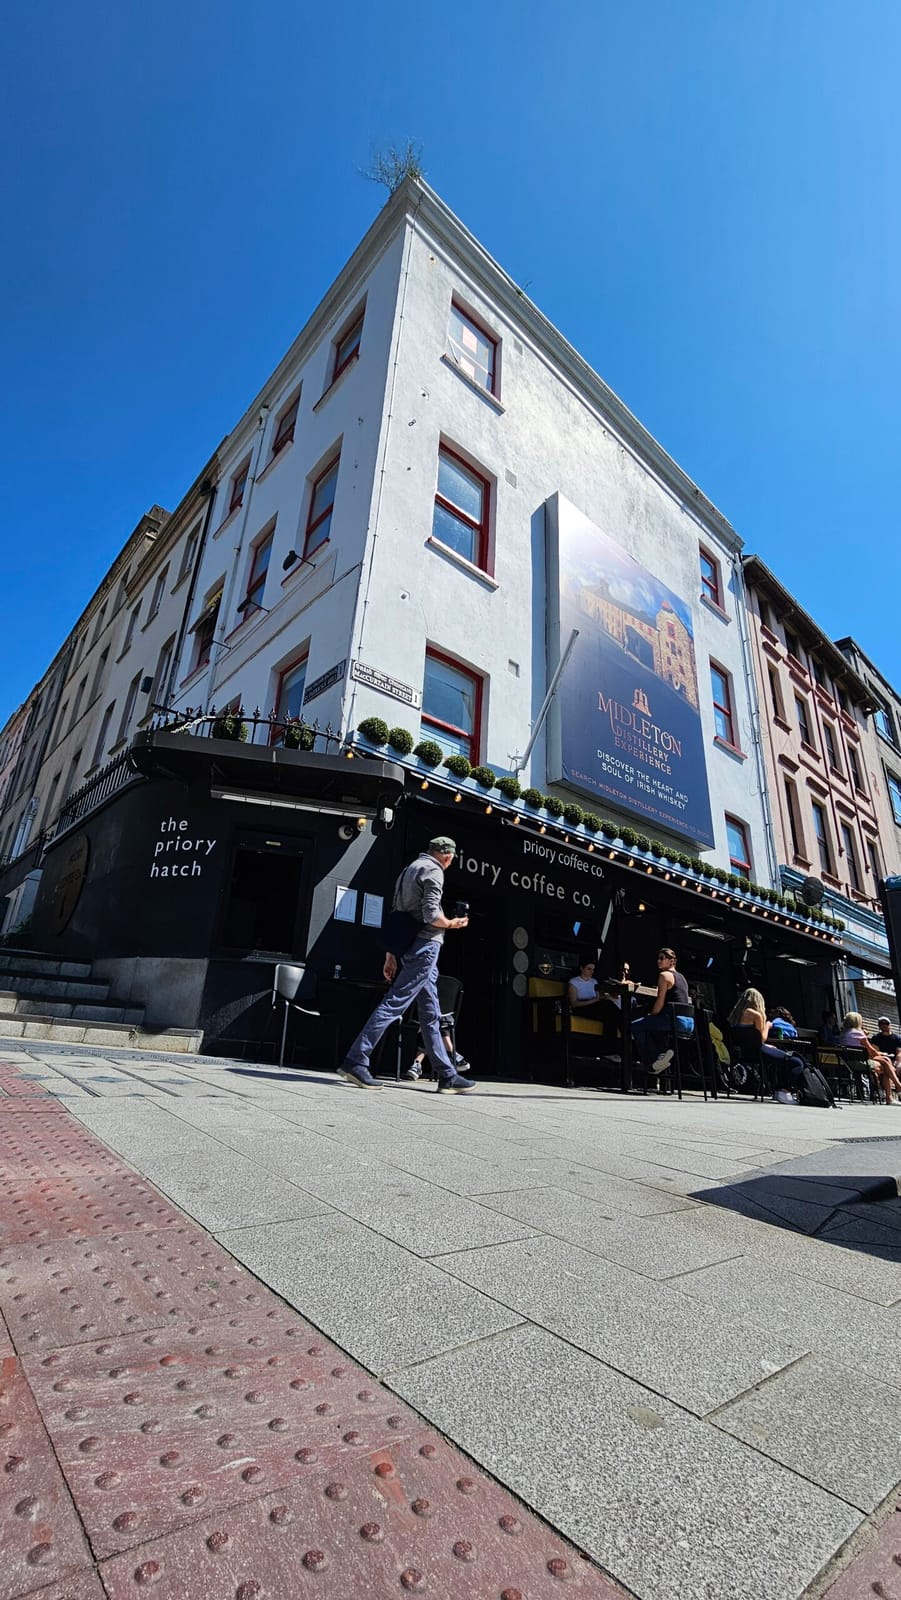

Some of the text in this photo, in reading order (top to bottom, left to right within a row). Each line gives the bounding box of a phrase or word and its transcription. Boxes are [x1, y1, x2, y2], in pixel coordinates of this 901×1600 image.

[392, 685, 412, 703] STREET
[597, 691, 682, 758] MIDLETON
[616, 726, 669, 762] DISTILLERY
[614, 737, 672, 775] EXPERIENCE
[597, 750, 689, 803] DISCOVER THE HEART AND
[601, 762, 686, 811] SOUL OF IRISH WHISKEY
[571, 769, 597, 786] SEARCH
[598, 784, 627, 801] MIDLETON
[627, 796, 658, 815] DISTILLERY
[659, 810, 689, 830] EXPERIENCE
[160, 816, 188, 833] the
[154, 835, 217, 857] priory
[523, 839, 605, 879] priory coffee co.
[150, 860, 202, 878] hatch
[455, 850, 596, 909] iory coffee co.
